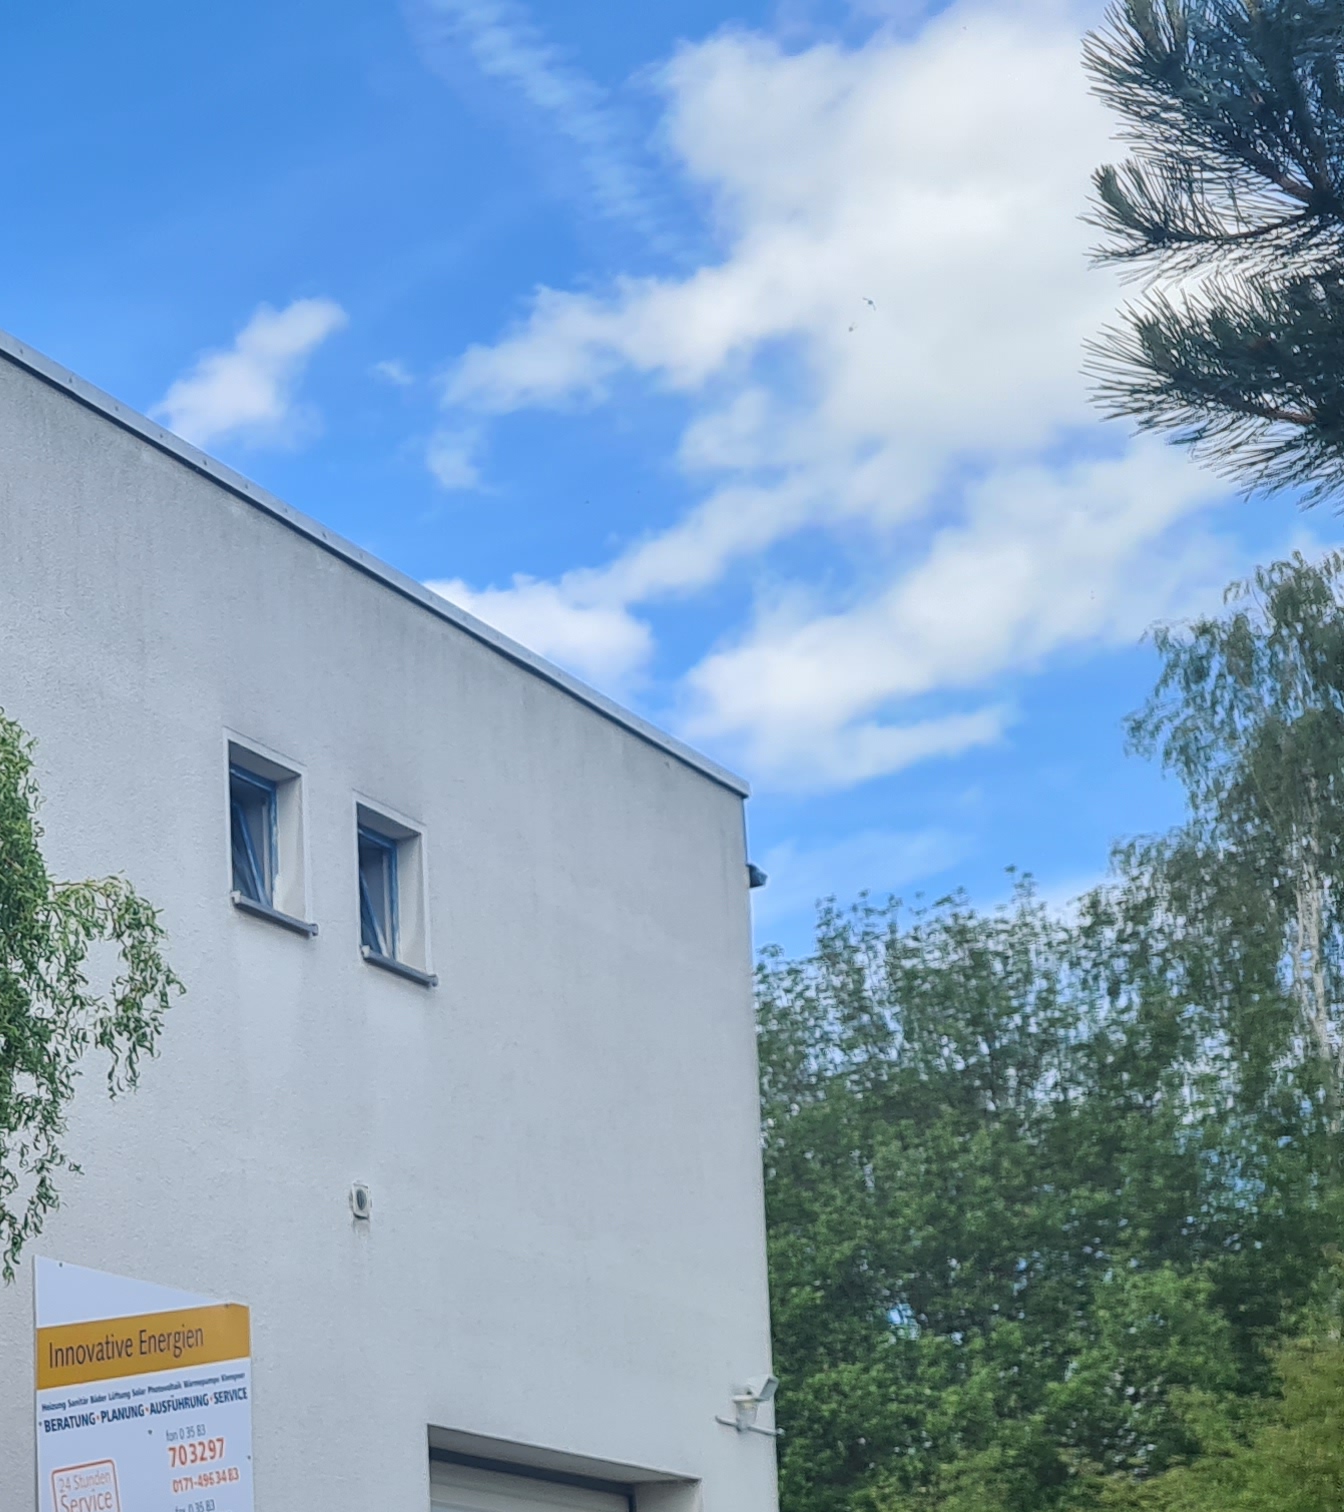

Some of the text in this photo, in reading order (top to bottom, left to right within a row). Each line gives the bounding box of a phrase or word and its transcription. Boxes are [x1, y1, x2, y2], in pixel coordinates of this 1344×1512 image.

[49, 1323, 204, 1368] Innovative Energien
[43, 1387, 248, 1433] BERATUNG PLANUNG AUSFÜHRUNG SERVICE
[166, 1423, 206, 1441] fon 0 35 83
[59, 1470, 111, 1493] 24 Stunden
[205, 1499, 215, 1512] 83
